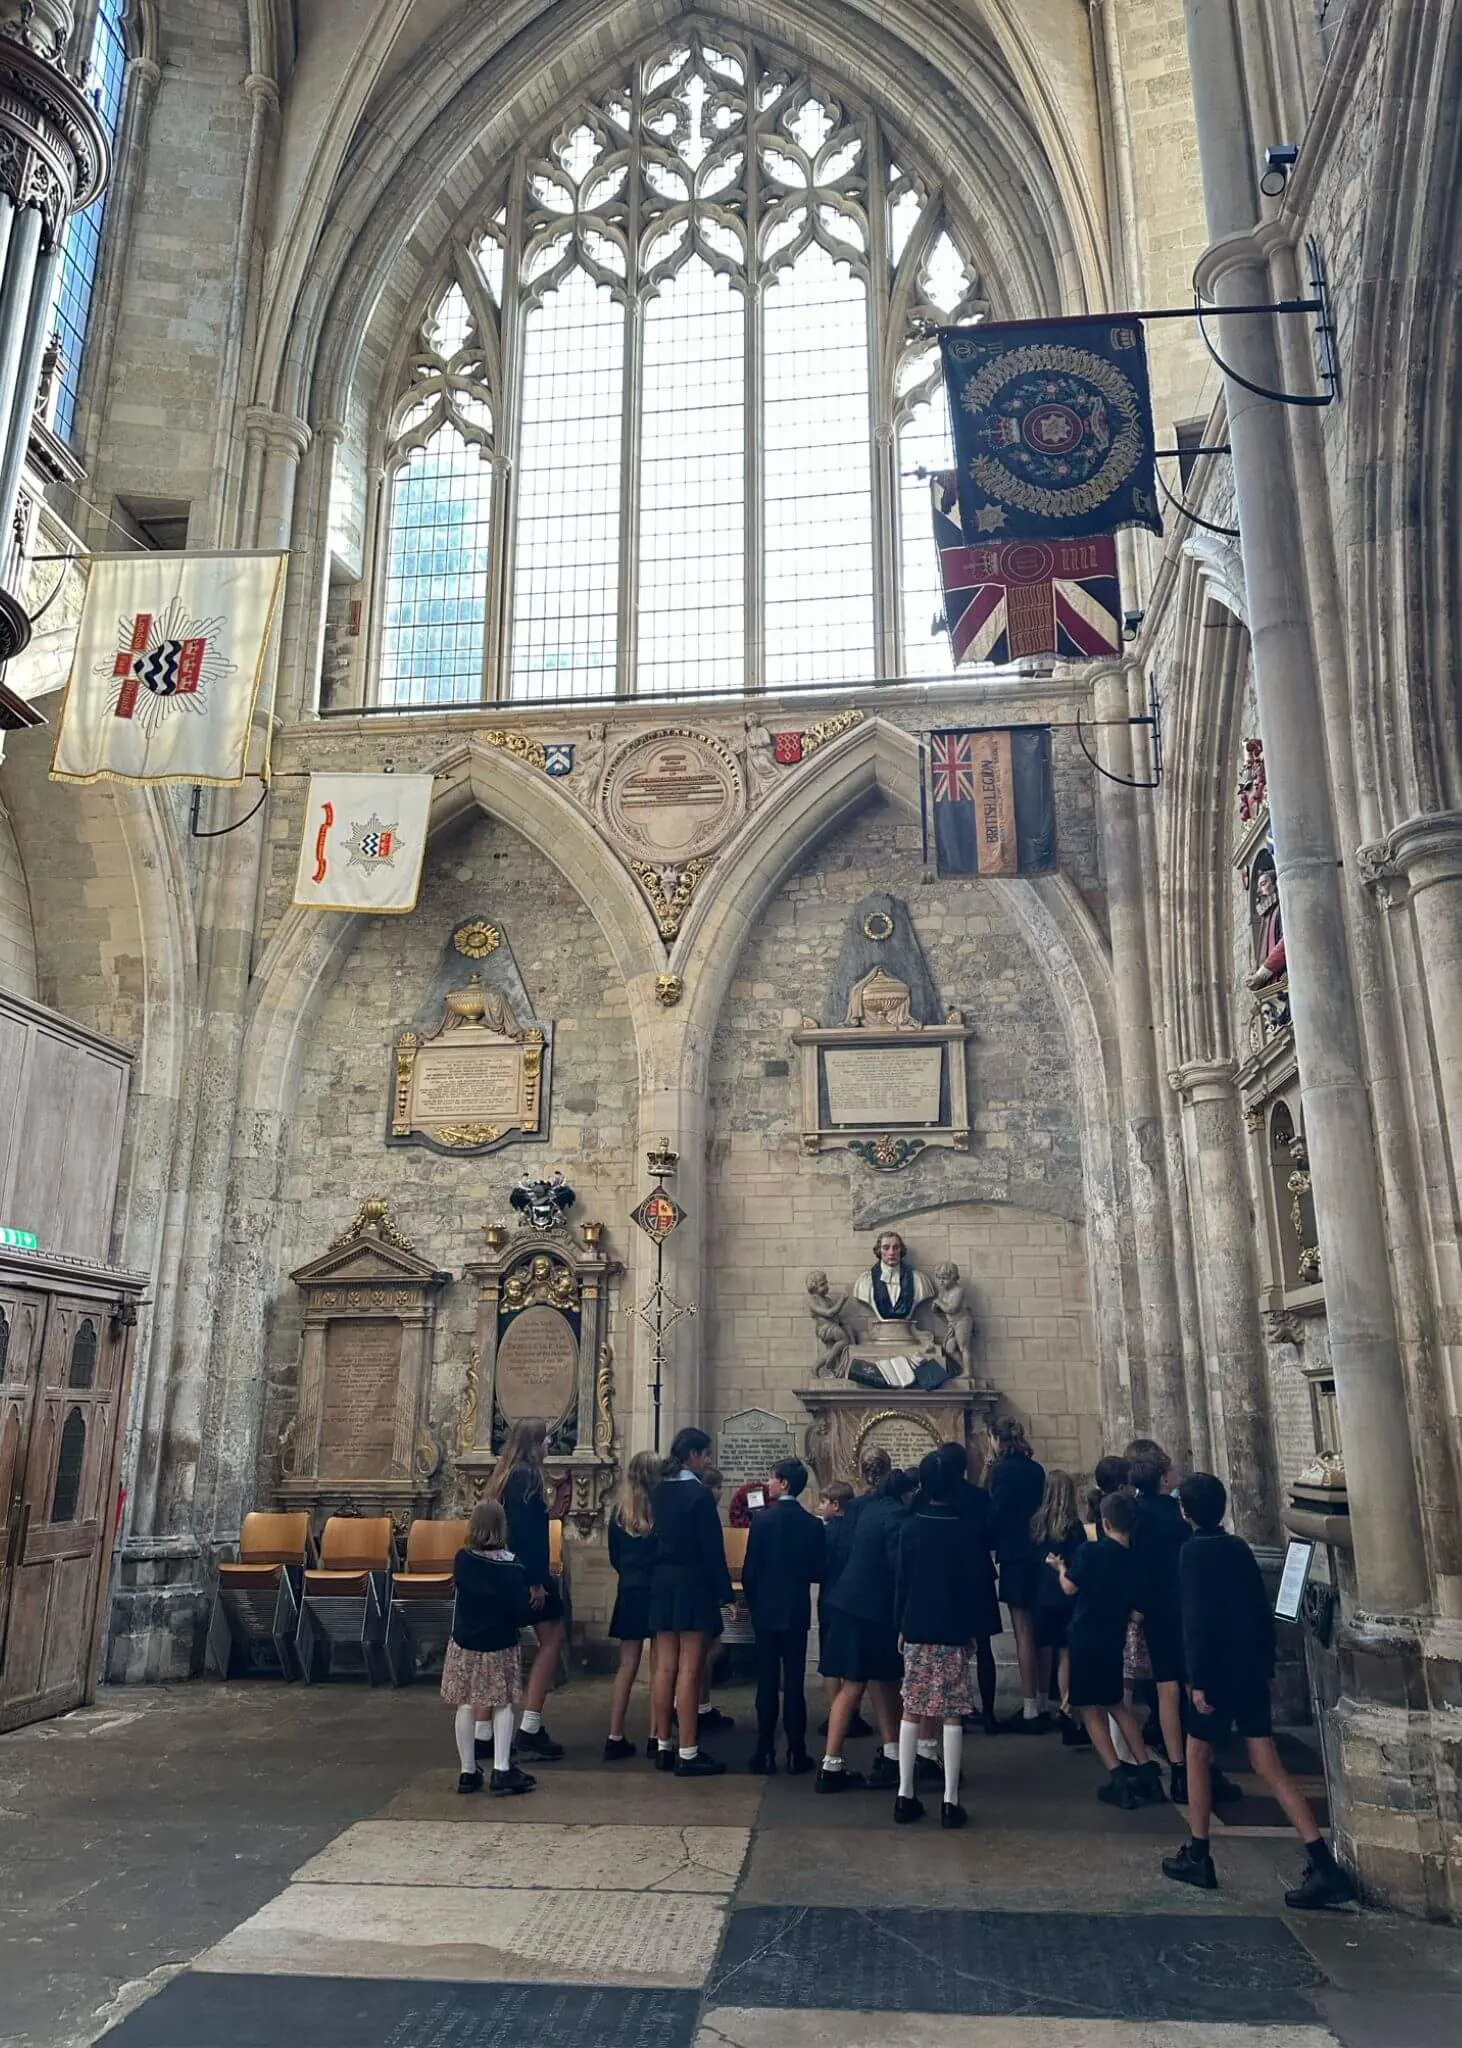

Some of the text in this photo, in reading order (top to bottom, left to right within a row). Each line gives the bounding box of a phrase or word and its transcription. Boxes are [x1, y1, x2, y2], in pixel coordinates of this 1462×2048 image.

[134, 615, 149, 649] London
[980, 759, 996, 800] LEGION
[983, 804, 999, 844] BRITISH
